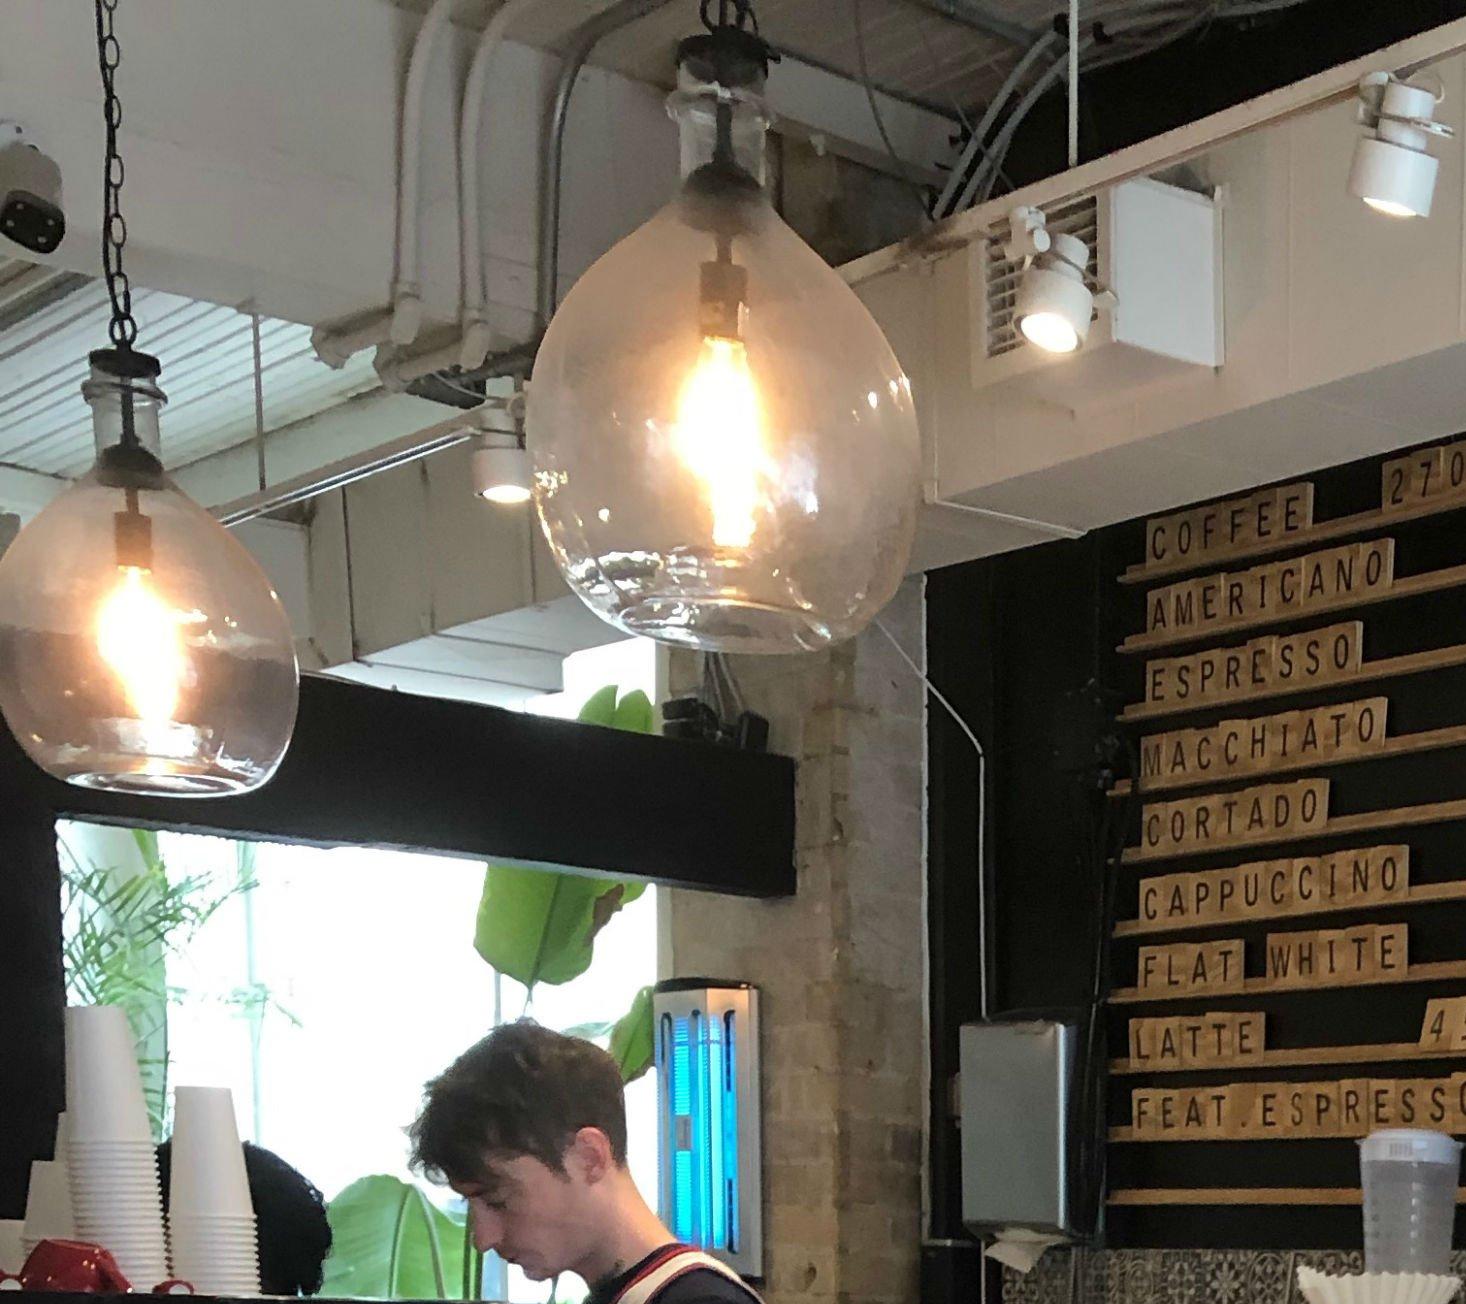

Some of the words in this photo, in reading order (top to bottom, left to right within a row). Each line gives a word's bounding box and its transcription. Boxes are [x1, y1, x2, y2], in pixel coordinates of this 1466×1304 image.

[1152, 498, 1300, 558] COFFEE
[1152, 550, 1383, 631] AMERICANO
[1152, 634, 1350, 700] ESPRESSO
[1143, 708, 1375, 777] MACCHIATO
[1147, 790, 1317, 847] CORTADO
[1145, 857, 1396, 921] CAPPUCCINO
[1145, 950, 1233, 988] FLAT
[1269, 935, 1395, 976] WHITE
[1136, 1021, 1253, 1059] LATTE
